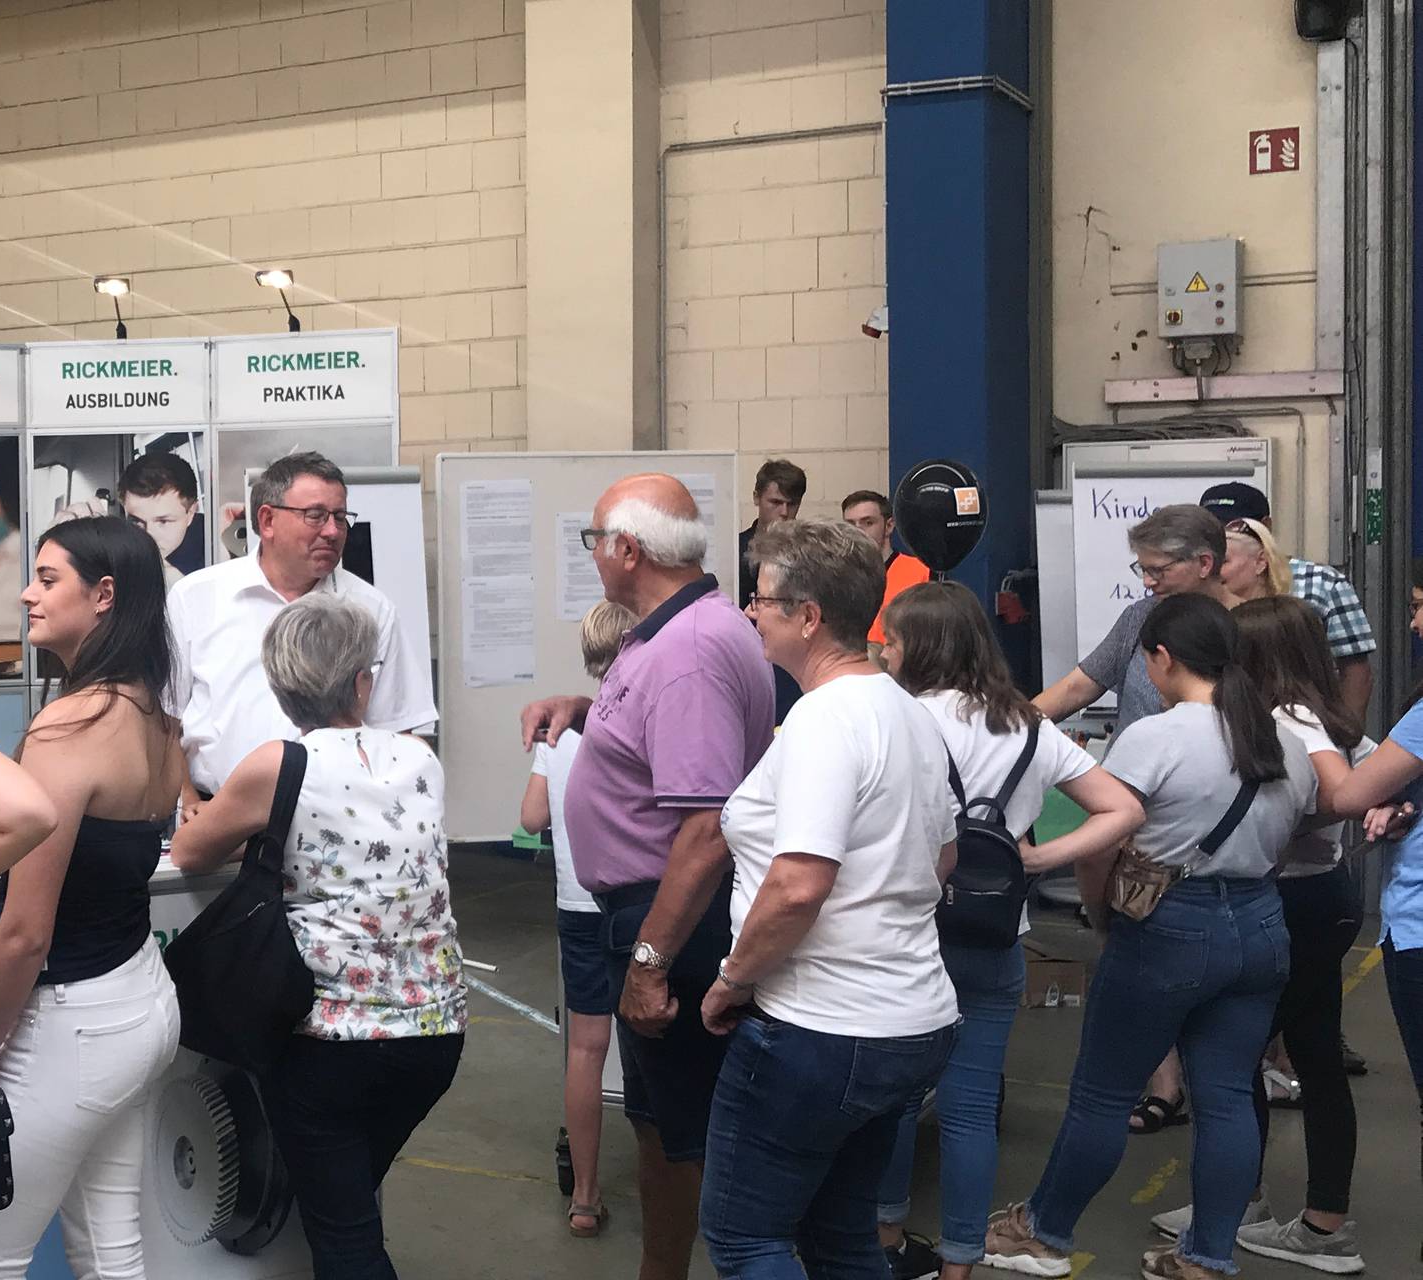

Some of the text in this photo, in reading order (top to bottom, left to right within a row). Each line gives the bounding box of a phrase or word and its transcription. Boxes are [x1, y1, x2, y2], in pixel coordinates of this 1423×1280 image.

[61, 359, 178, 379] RICKMEIER.
[247, 350, 366, 374] RICKMEIER.
[65, 391, 170, 409] AUSBILDUNG
[263, 385, 345, 403] PRAKTIKA
